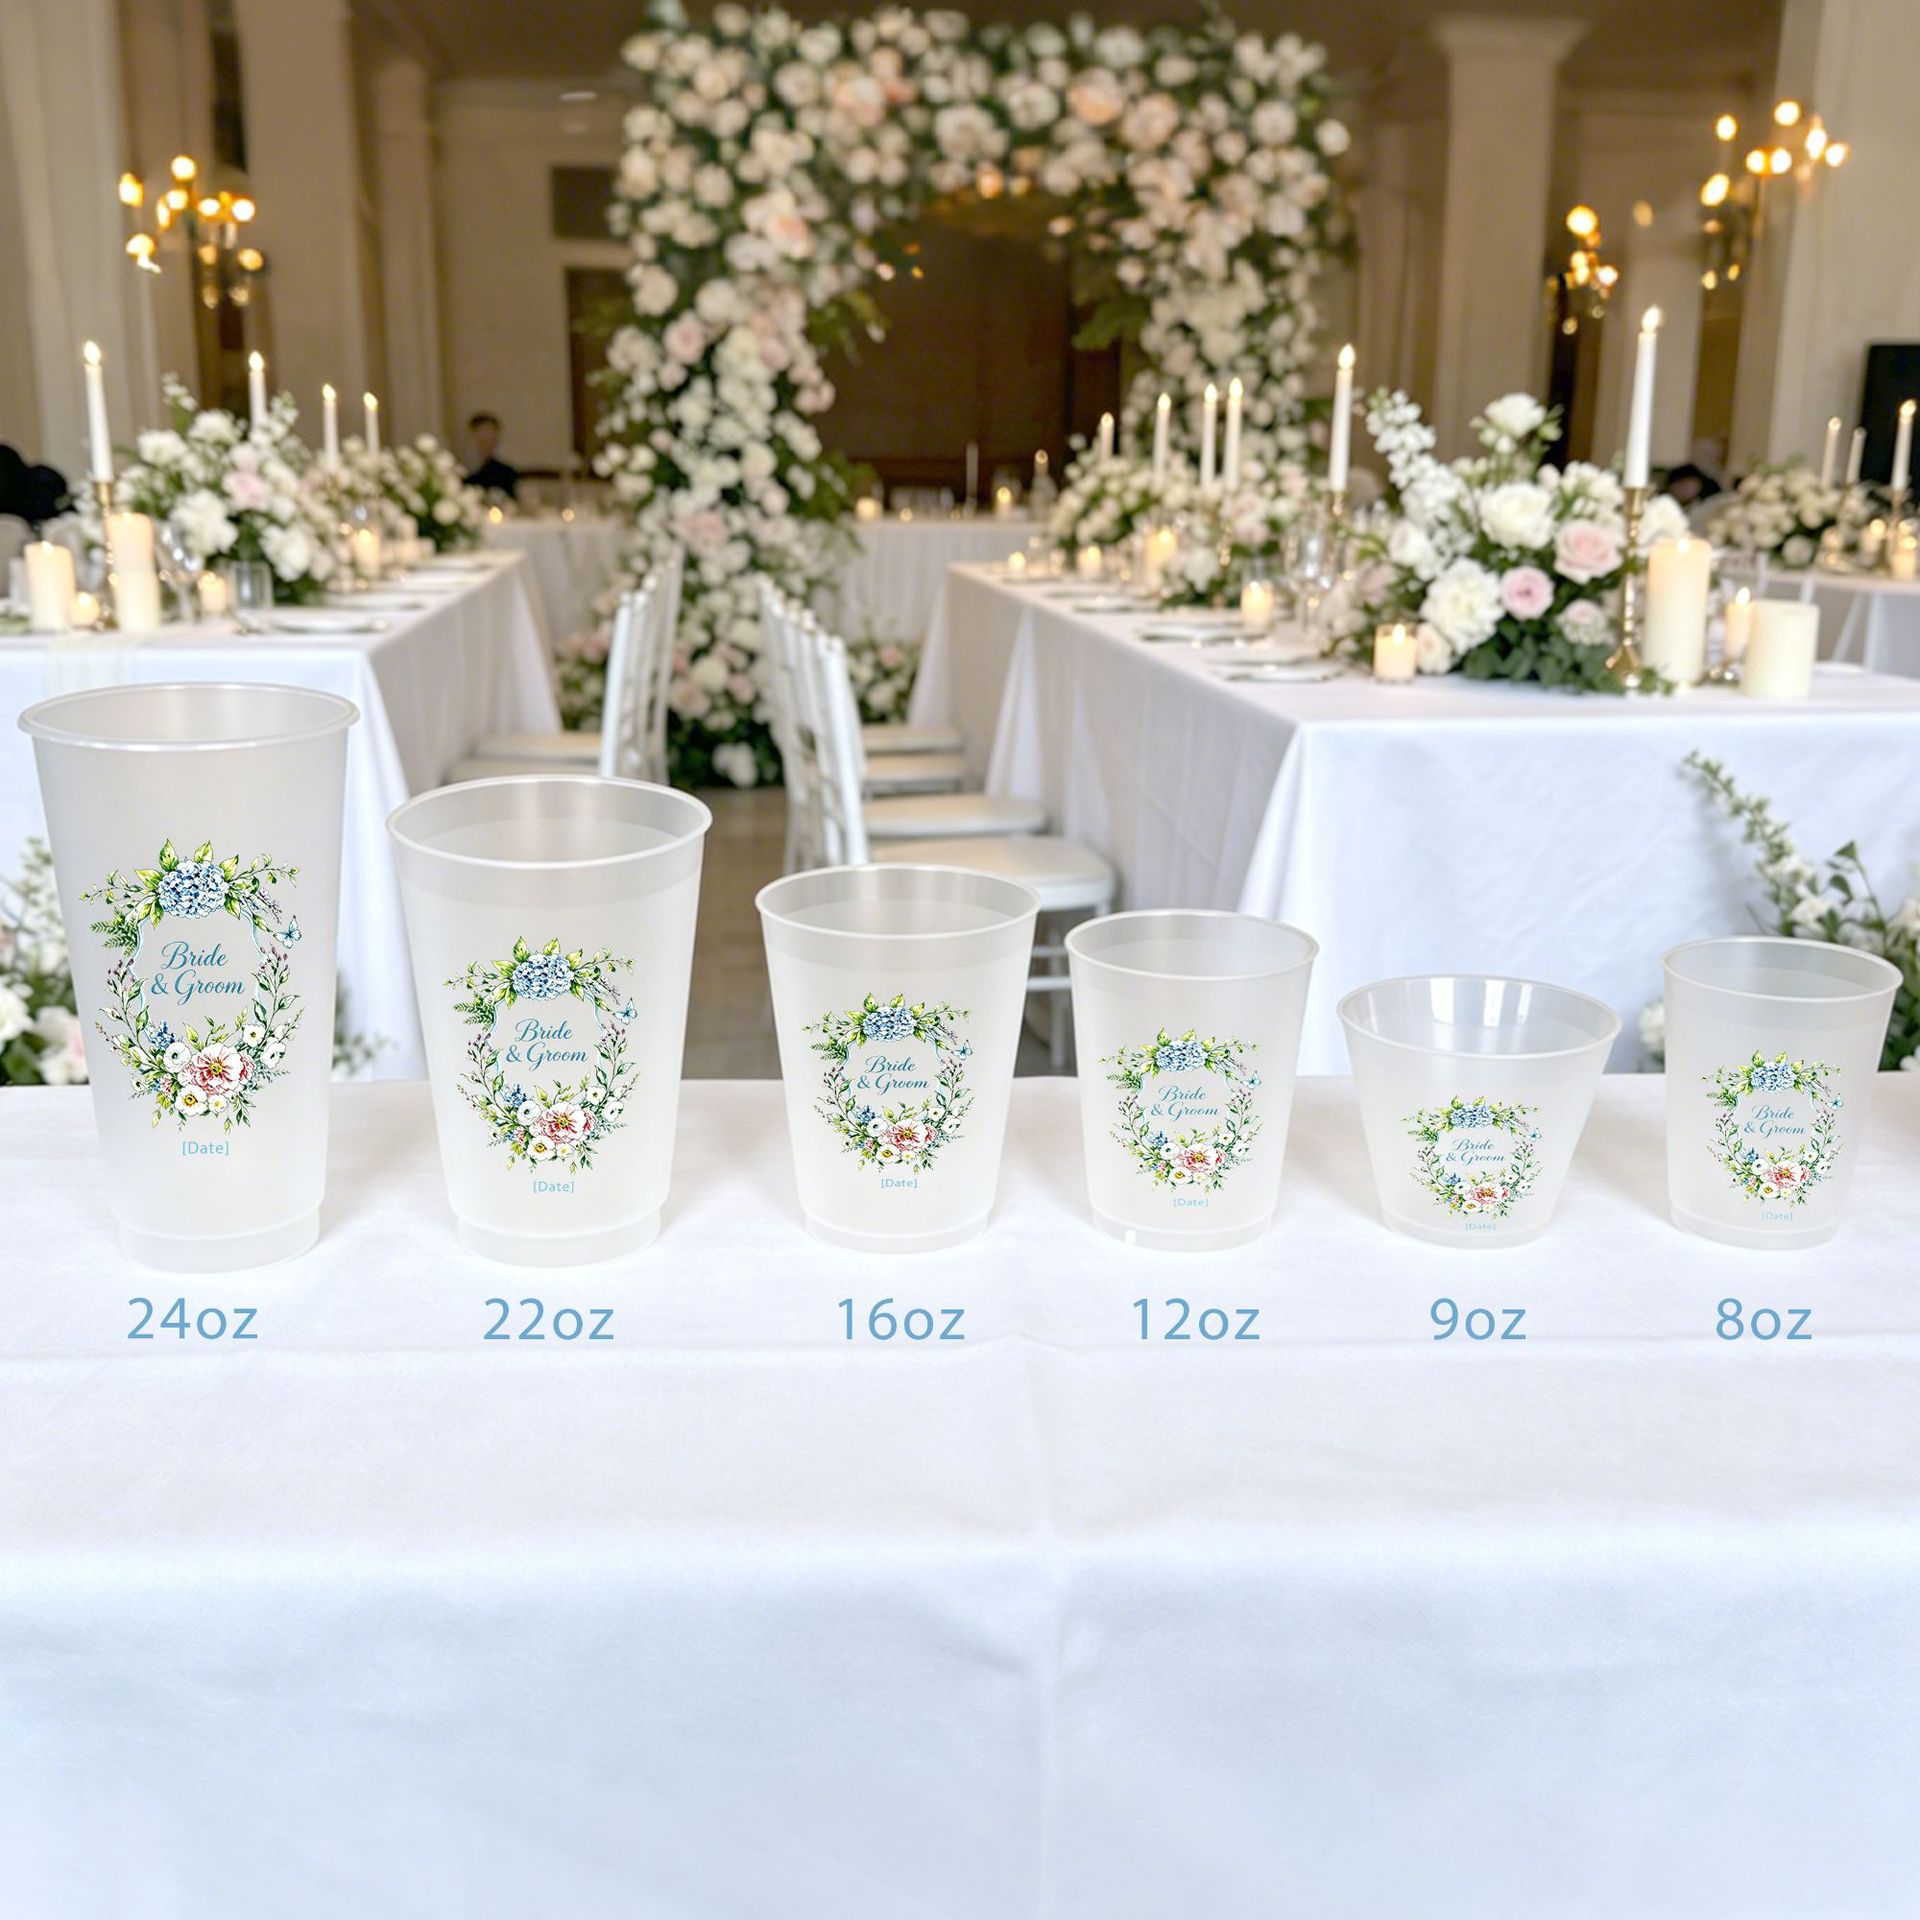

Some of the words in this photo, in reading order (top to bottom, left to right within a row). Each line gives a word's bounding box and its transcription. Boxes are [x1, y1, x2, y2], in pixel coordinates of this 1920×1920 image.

[161, 941, 228, 970] Bride
[151, 973, 169, 995] &
[174, 969, 246, 1006] Groom
[515, 1018, 573, 1042] Bride
[506, 1044, 521, 1062] &
[526, 1041, 588, 1072] Groom
[865, 1055, 917, 1073] Bride
[857, 1075, 871, 1089] &
[875, 1072, 929, 1096] Groom
[1159, 1085, 1207, 1101] Bride
[1150, 1103, 1164, 1116] &
[1167, 1101, 1219, 1121] Groom
[1752, 1104, 1794, 1119] Bride
[1743, 1121, 1756, 1133] &
[1759, 1120, 1806, 1139] Groom
[182, 1141, 229, 1156] [Date]
[1453, 1138, 1494, 1151] Bride
[1445, 1152, 1456, 1162] &
[533, 1180, 574, 1193] [Date]
[881, 1178, 918, 1189] [Date]
